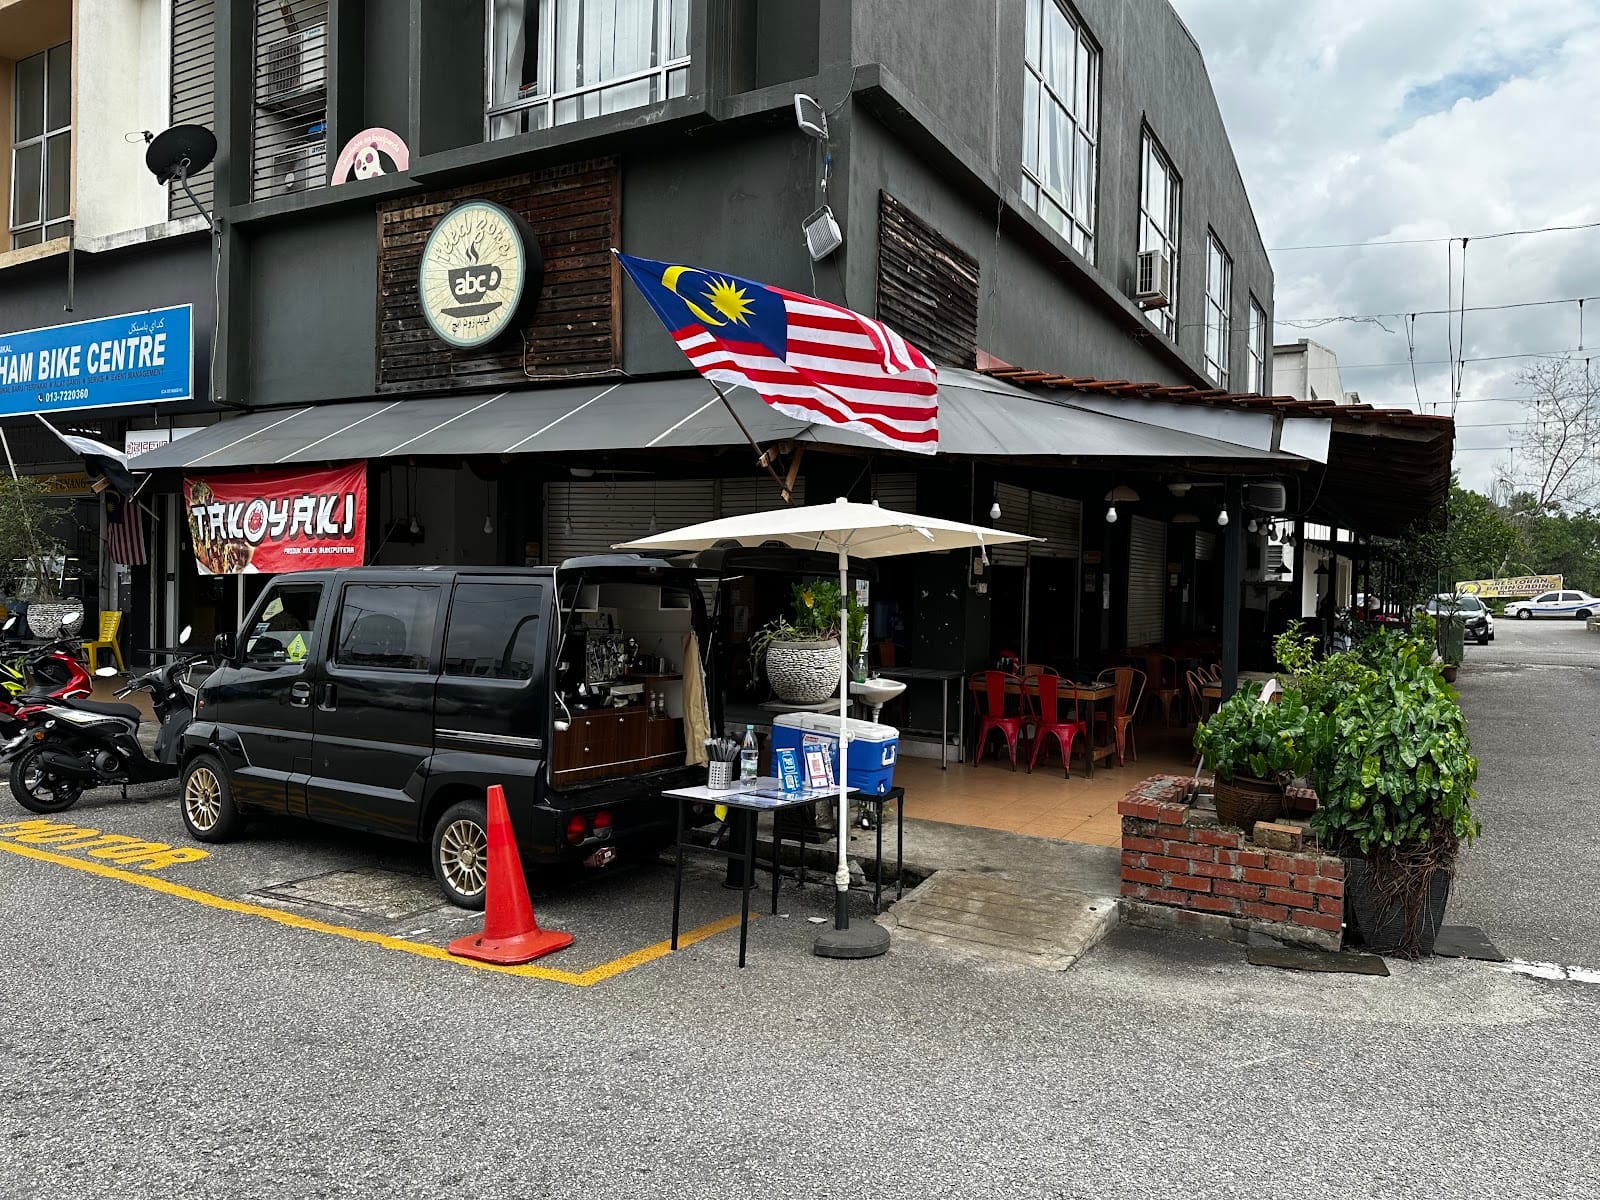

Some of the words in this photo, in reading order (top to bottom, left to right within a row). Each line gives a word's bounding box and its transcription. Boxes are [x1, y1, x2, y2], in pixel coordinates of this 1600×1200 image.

[454, 271, 487, 296] abc
[38, 345, 82, 381] BIKE
[87, 333, 167, 375] CENTRE
[191, 493, 355, 544] TAKOYAKI
